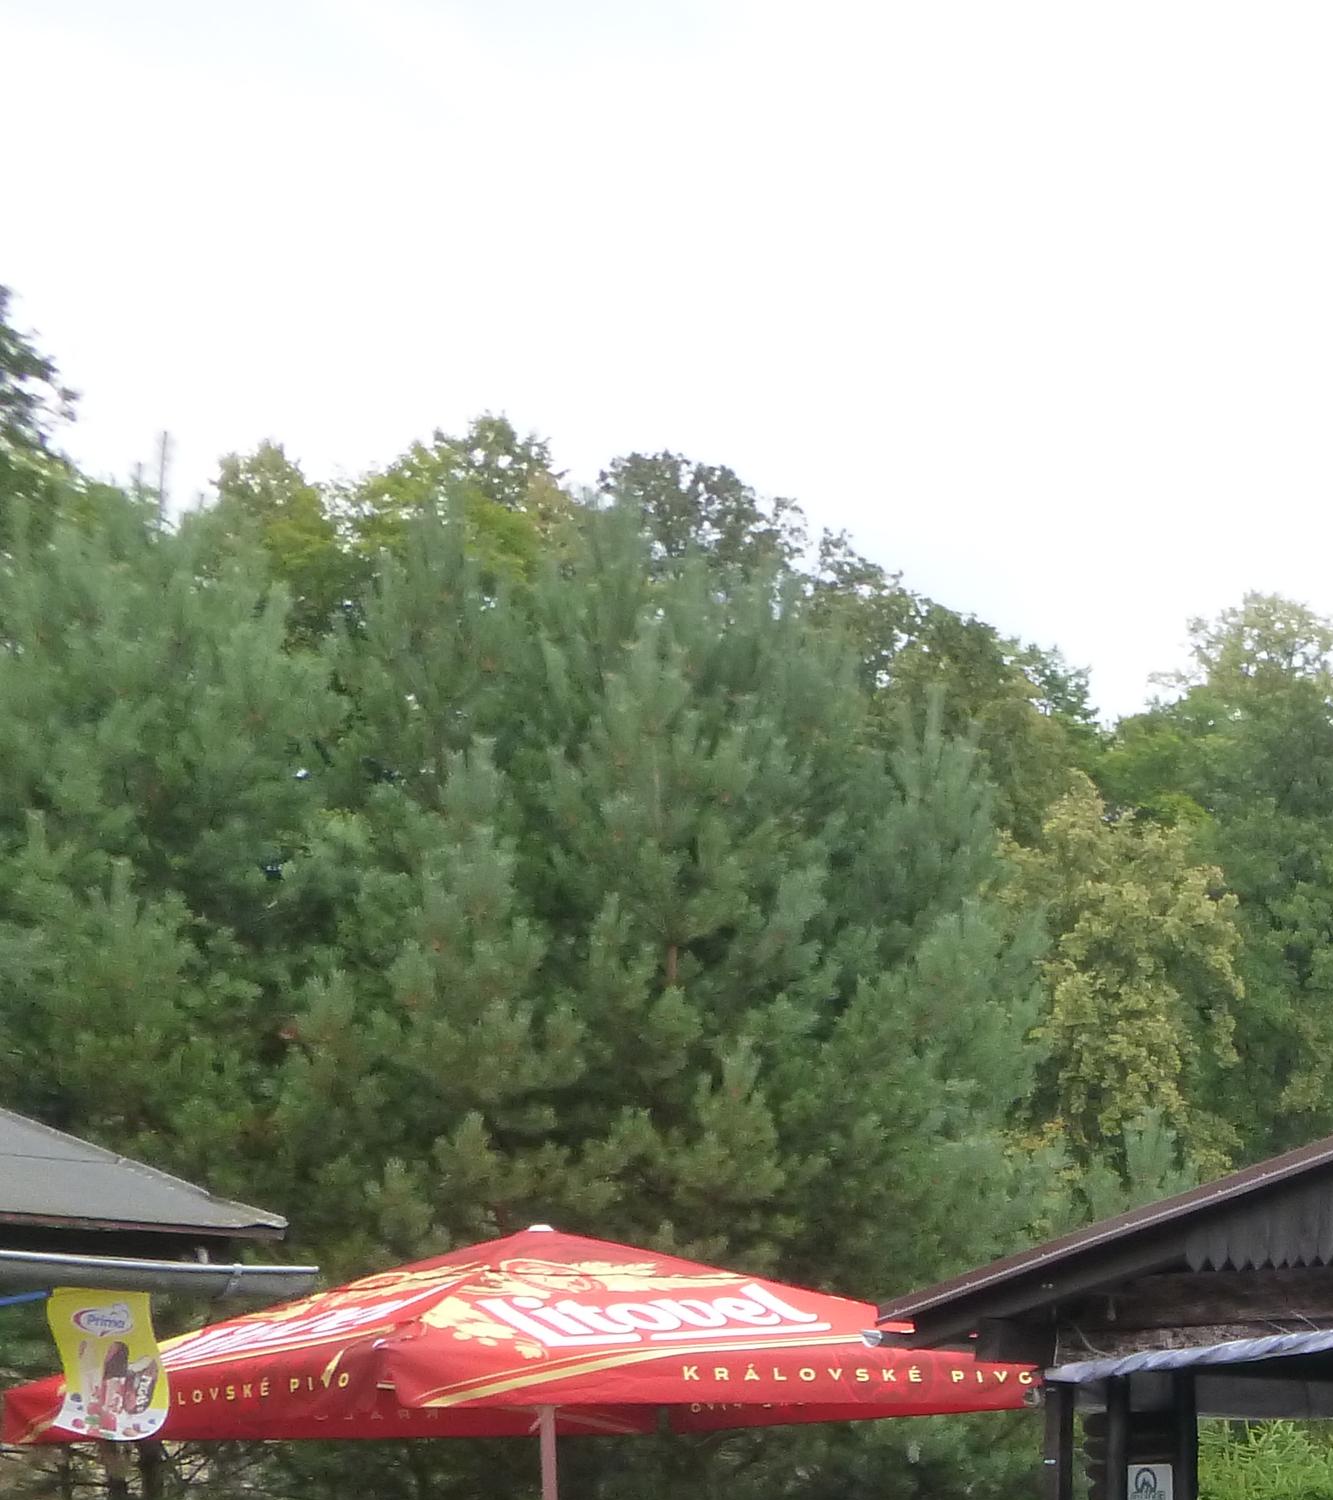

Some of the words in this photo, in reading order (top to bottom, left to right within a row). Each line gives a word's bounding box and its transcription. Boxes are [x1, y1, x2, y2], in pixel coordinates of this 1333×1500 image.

[87, 1314, 126, 1329] Prima
[475, 1282, 818, 1347] Litovel
[289, 1372, 350, 1393] PIVO
[682, 1363, 923, 1383] KRÁLOVSKÉ
